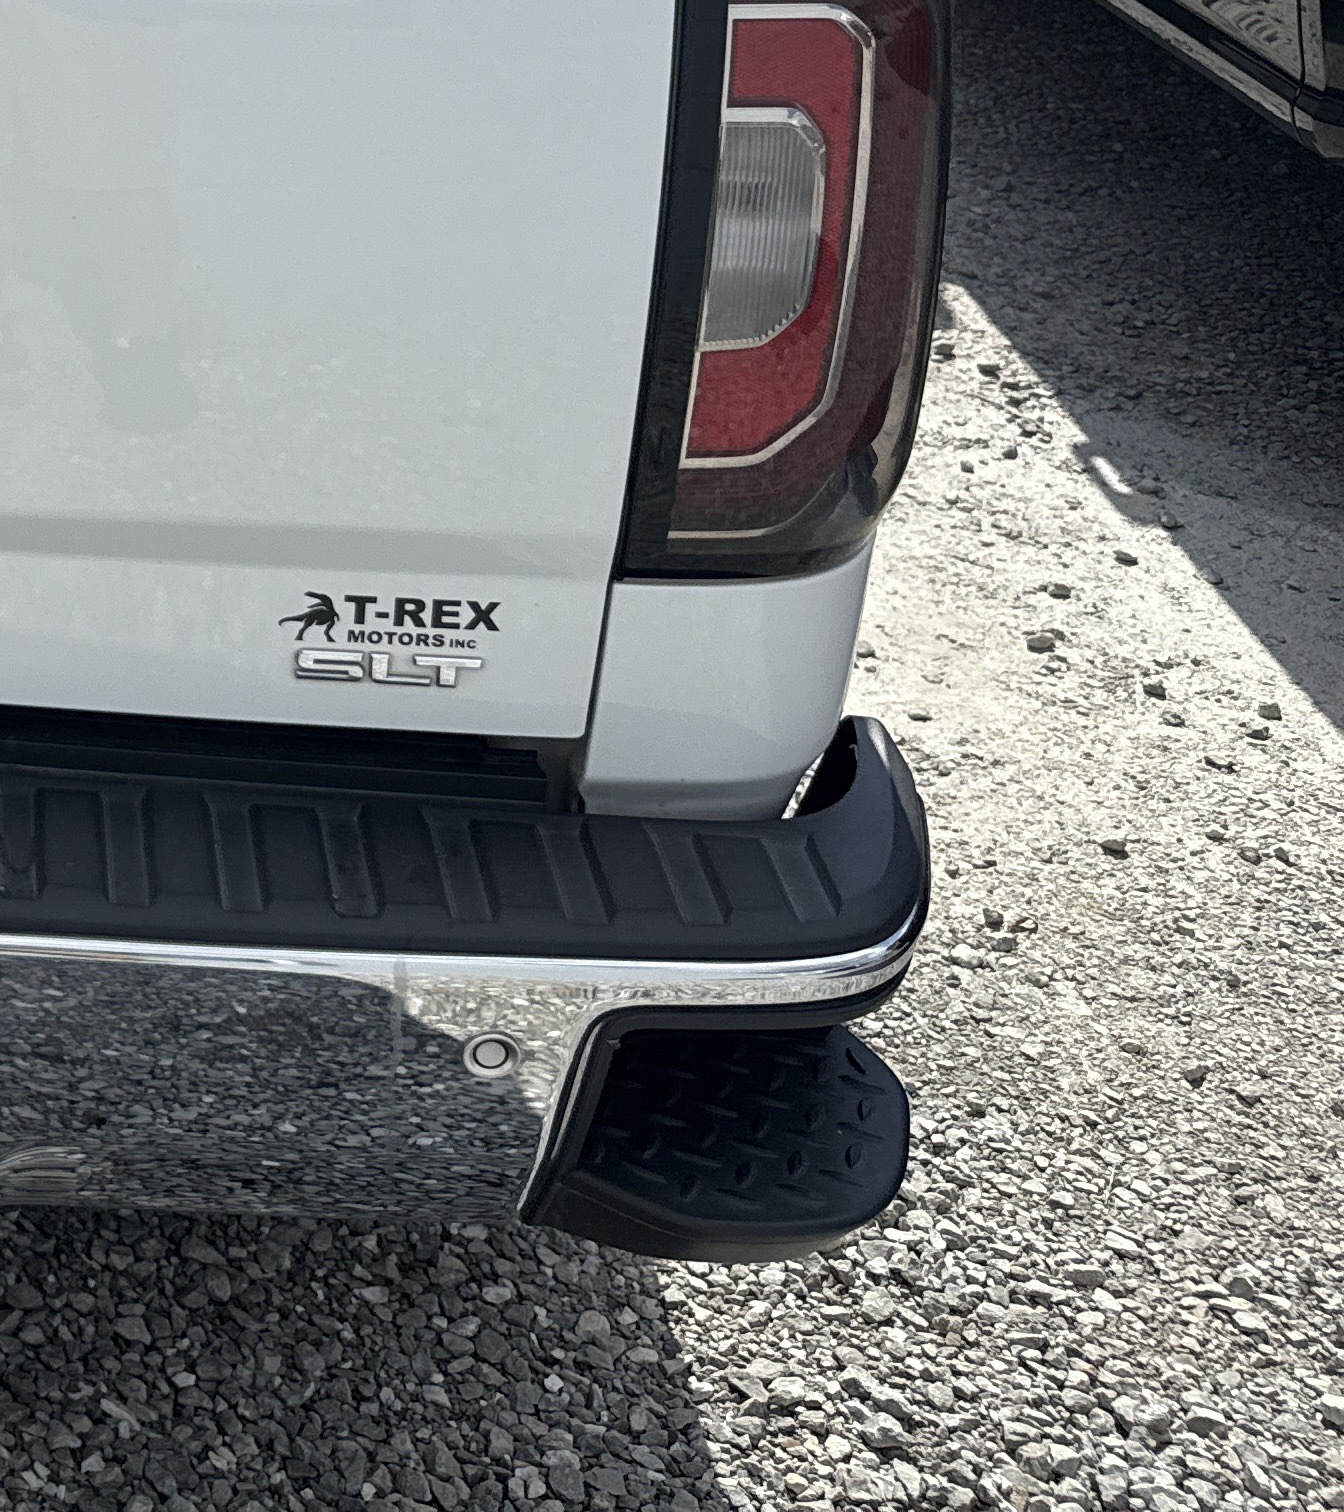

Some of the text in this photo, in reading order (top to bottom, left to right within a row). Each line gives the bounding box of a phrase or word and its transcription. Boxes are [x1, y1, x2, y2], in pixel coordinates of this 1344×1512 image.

[344, 594, 501, 631] T-REX
[347, 629, 477, 649] MOTORS INC
[296, 647, 483, 688] SLT
